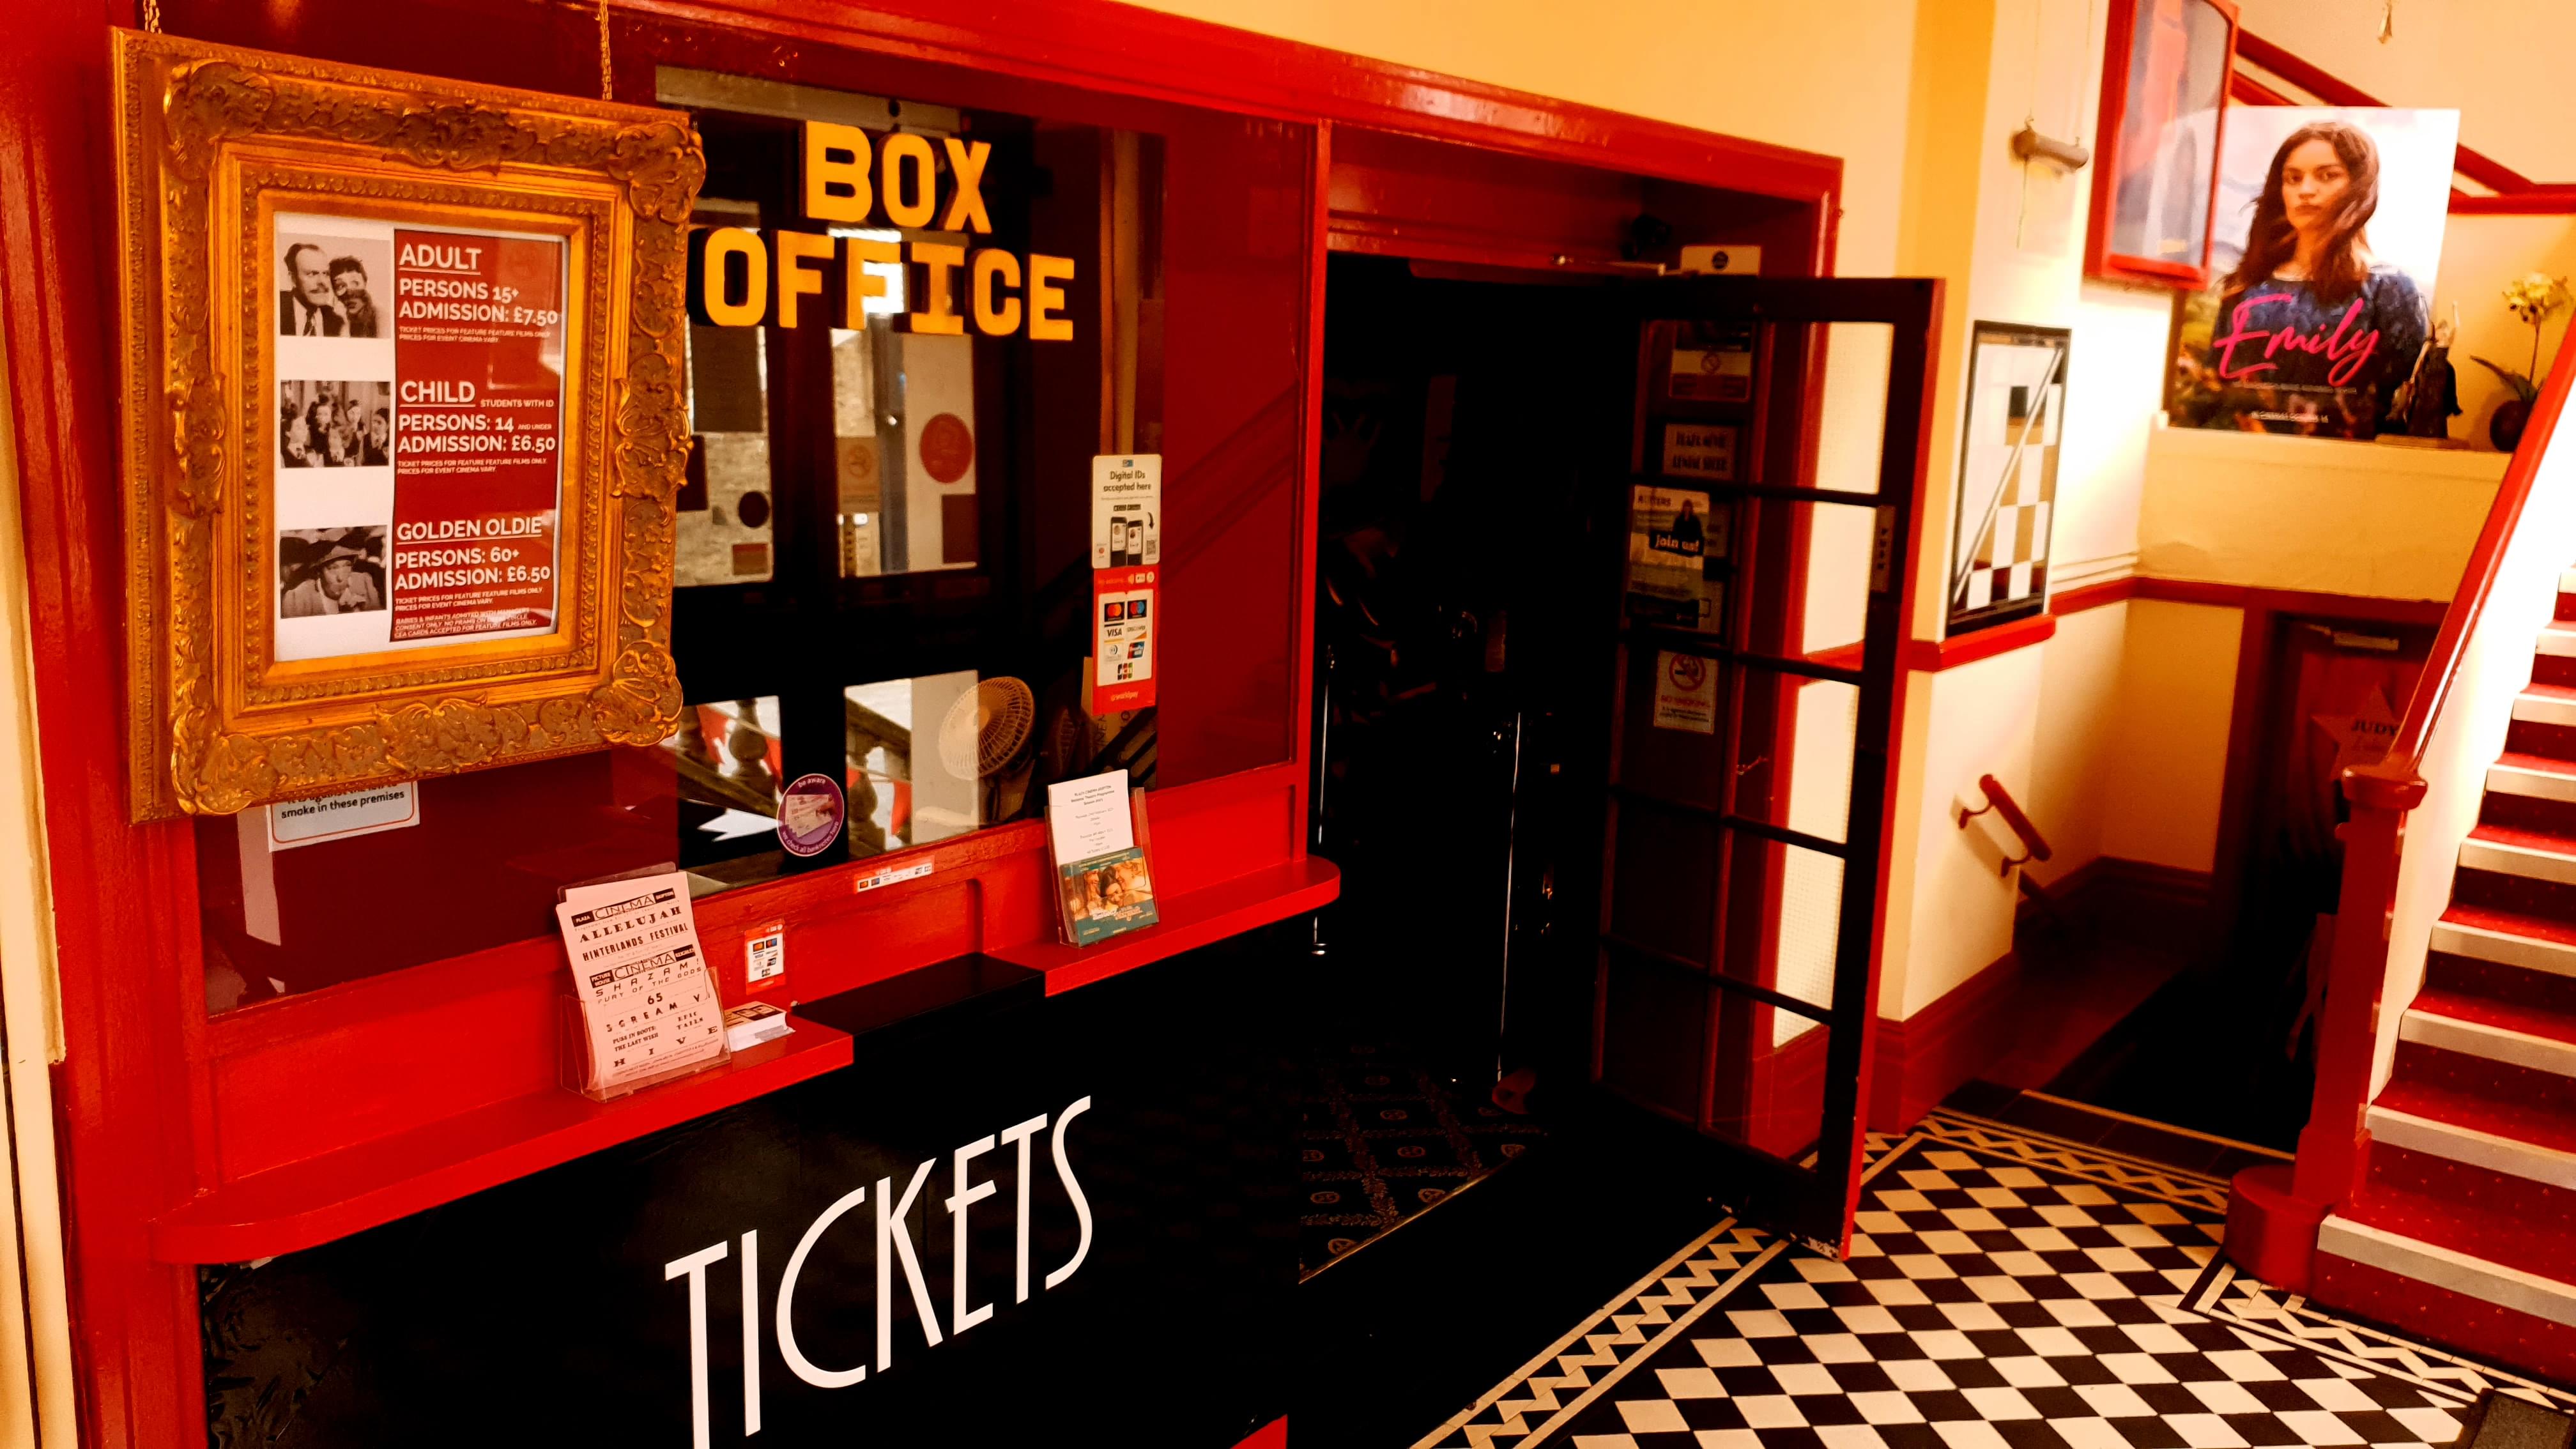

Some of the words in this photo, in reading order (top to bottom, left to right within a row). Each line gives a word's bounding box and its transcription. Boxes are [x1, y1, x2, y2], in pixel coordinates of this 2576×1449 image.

[806, 120, 992, 233] BOX
[399, 243, 482, 270] ADULT
[400, 278, 488, 300] PERSONS
[492, 287, 519, 303] 15+
[704, 227, 1074, 341] OFFICE
[399, 301, 509, 322] ADMISSION:
[514, 306, 558, 327] £7.50
[459, 328, 486, 336] FEATURE
[2213, 293, 2380, 387] Emily
[401, 381, 475, 403] CHILD
[480, 399, 522, 408] STUDENTS
[524, 399, 544, 408] WITH
[399, 414, 490, 432] PERSONS:
[495, 416, 514, 433] 14
[397, 434, 507, 454] ADMISSION:
[511, 435, 555, 454] £6.50
[1103, 482, 1135, 493] accepted
[1136, 482, 1151, 490] here
[1110, 470, 1133, 482] Digital
[1135, 470, 1146, 479] IDs
[397, 519, 480, 540] GOLDEN
[486, 516, 542, 535] OLDIE
[1655, 534, 1678, 548] join
[395, 548, 486, 569] PERSONS:
[490, 546, 519, 563] 60+
[395, 567, 502, 590] ADMISSION:
[507, 565, 550, 583] £6.50
[429, 626, 462, 634] ACCEPTED
[1107, 628, 1123, 637] VISA
[281, 804, 316, 818] smoke
[318, 802, 327, 812] in
[330, 798, 358, 809] these
[360, 791, 404, 808] premises
[787, 839, 800, 852] check
[807, 836, 831, 854] banknotes
[576, 915, 591, 923] PLAZA
[595, 895, 656, 919] CINEMA
[579, 906, 682, 943] ALLELUJAH
[583, 935, 643, 962] HINTERLANDS
[650, 923, 689, 941] FESTIVAL
[591, 972, 611, 983] PICTURE
[614, 954, 676, 979] CINEMA
[595, 978, 610, 987] HOUSE
[598, 992, 624, 1004] FURY
[652, 977, 670, 986] THE
[677, 967, 702, 978] GODS
[648, 993, 663, 1005] 65
[606, 1002, 678, 1032] SCREAM
[677, 1011, 698, 1022] EPIC
[677, 1016, 704, 1030] TAILS
[613, 1035, 628, 1045] PUSS
[615, 1044, 626, 1052] THE
[627, 1039, 641, 1048] LAST
[643, 1032, 659, 1043] WISH
[664, 1095, 1092, 1449] TICKETS
